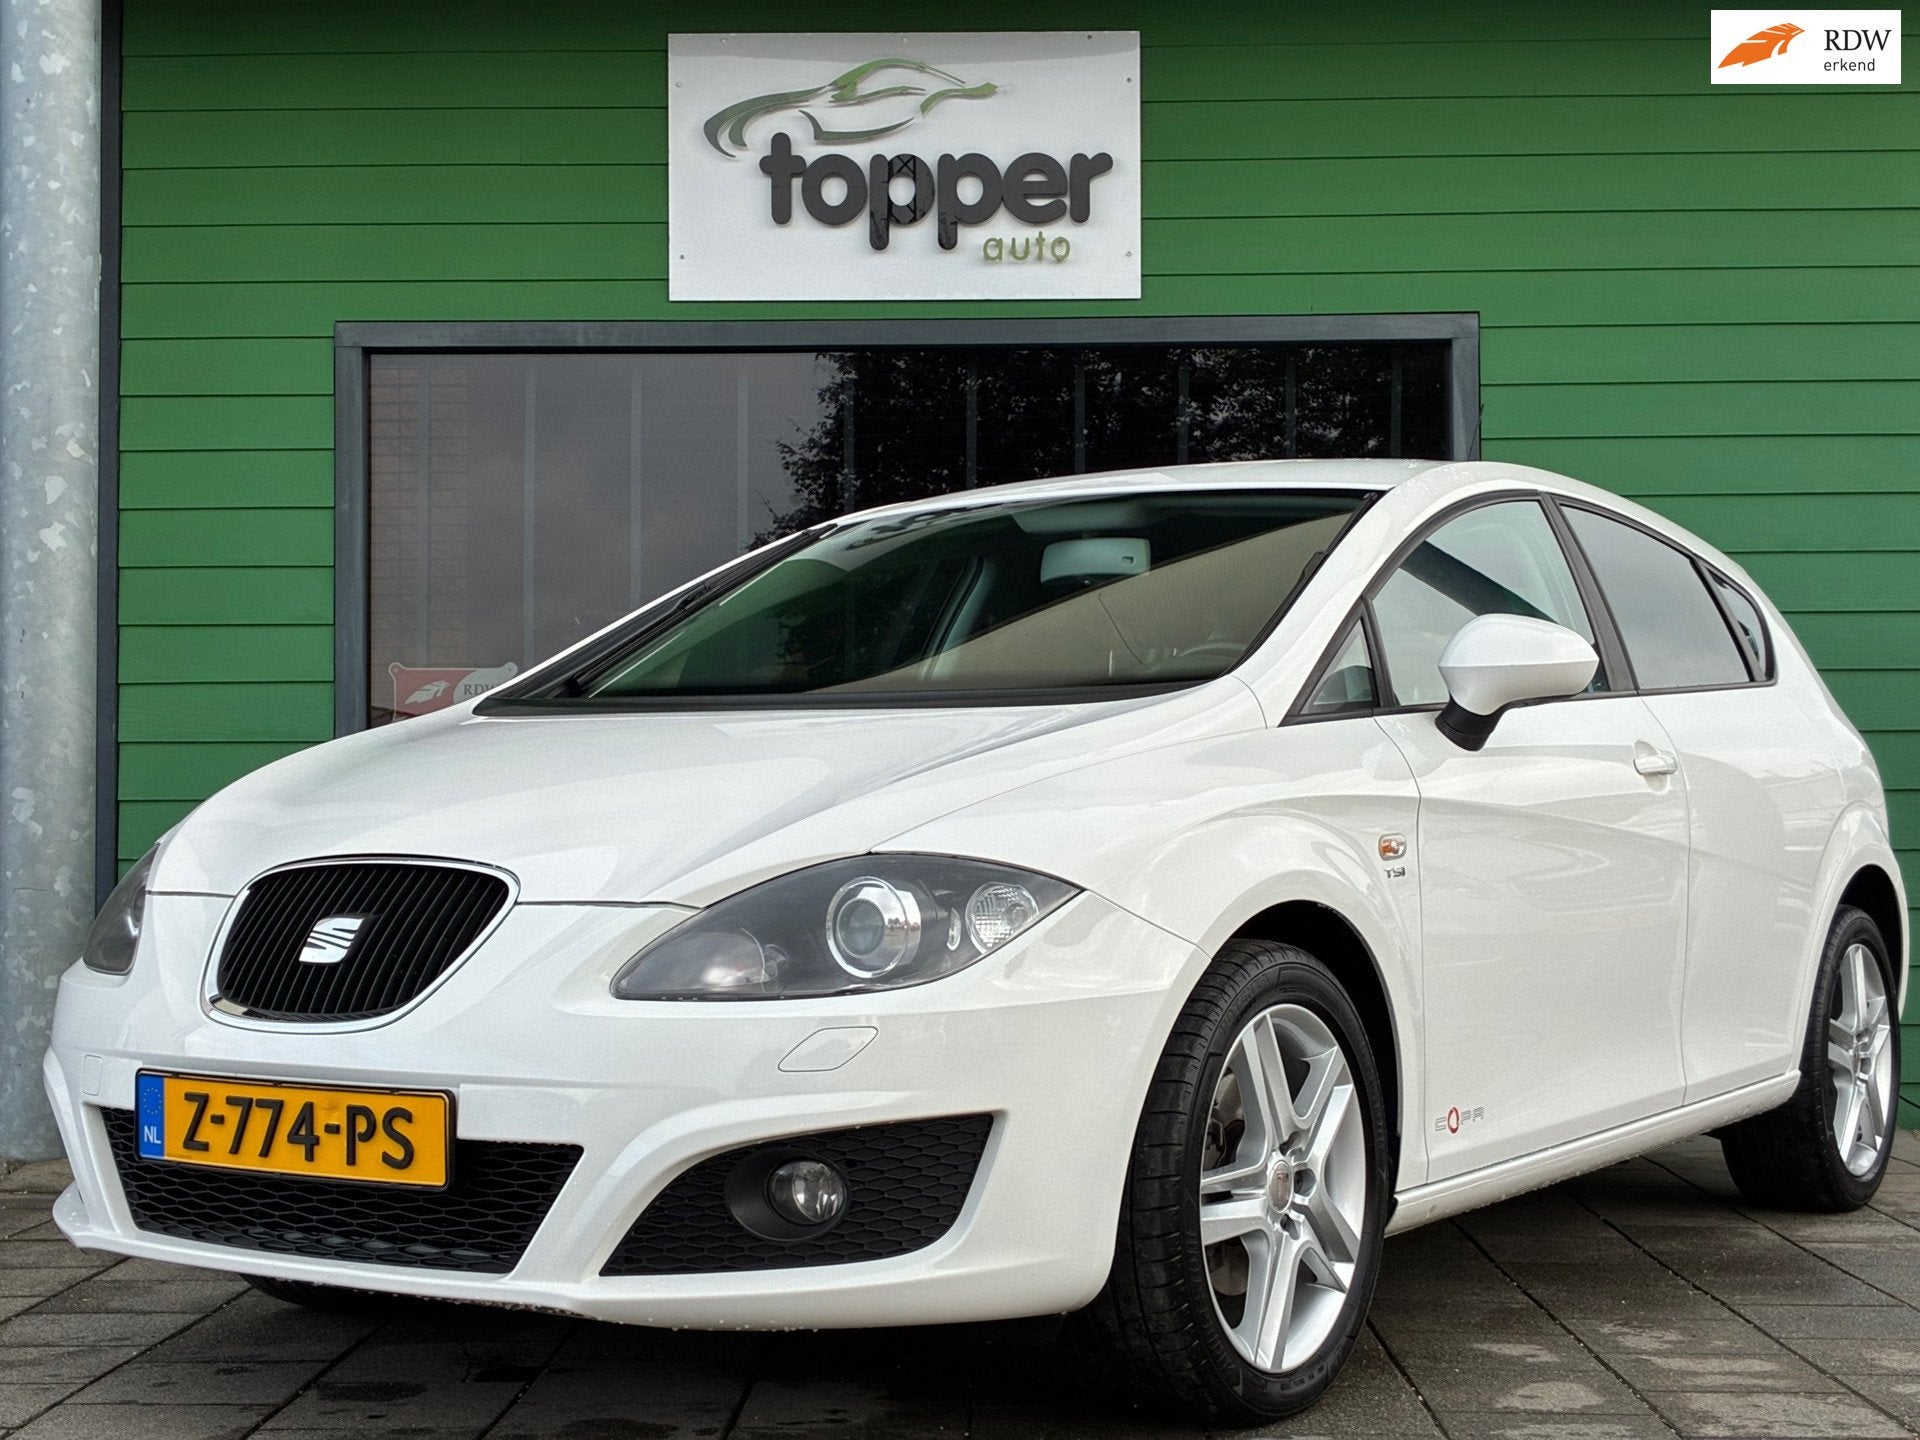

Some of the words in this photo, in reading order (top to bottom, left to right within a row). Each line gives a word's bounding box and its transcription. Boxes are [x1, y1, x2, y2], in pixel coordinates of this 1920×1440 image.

[759, 132, 1114, 251] topper
[982, 231, 1071, 262] auto
[143, 1125, 162, 1145] NL
[182, 1091, 415, 1170] Z-774-PS
[1434, 1106, 1485, 1134] COPA
